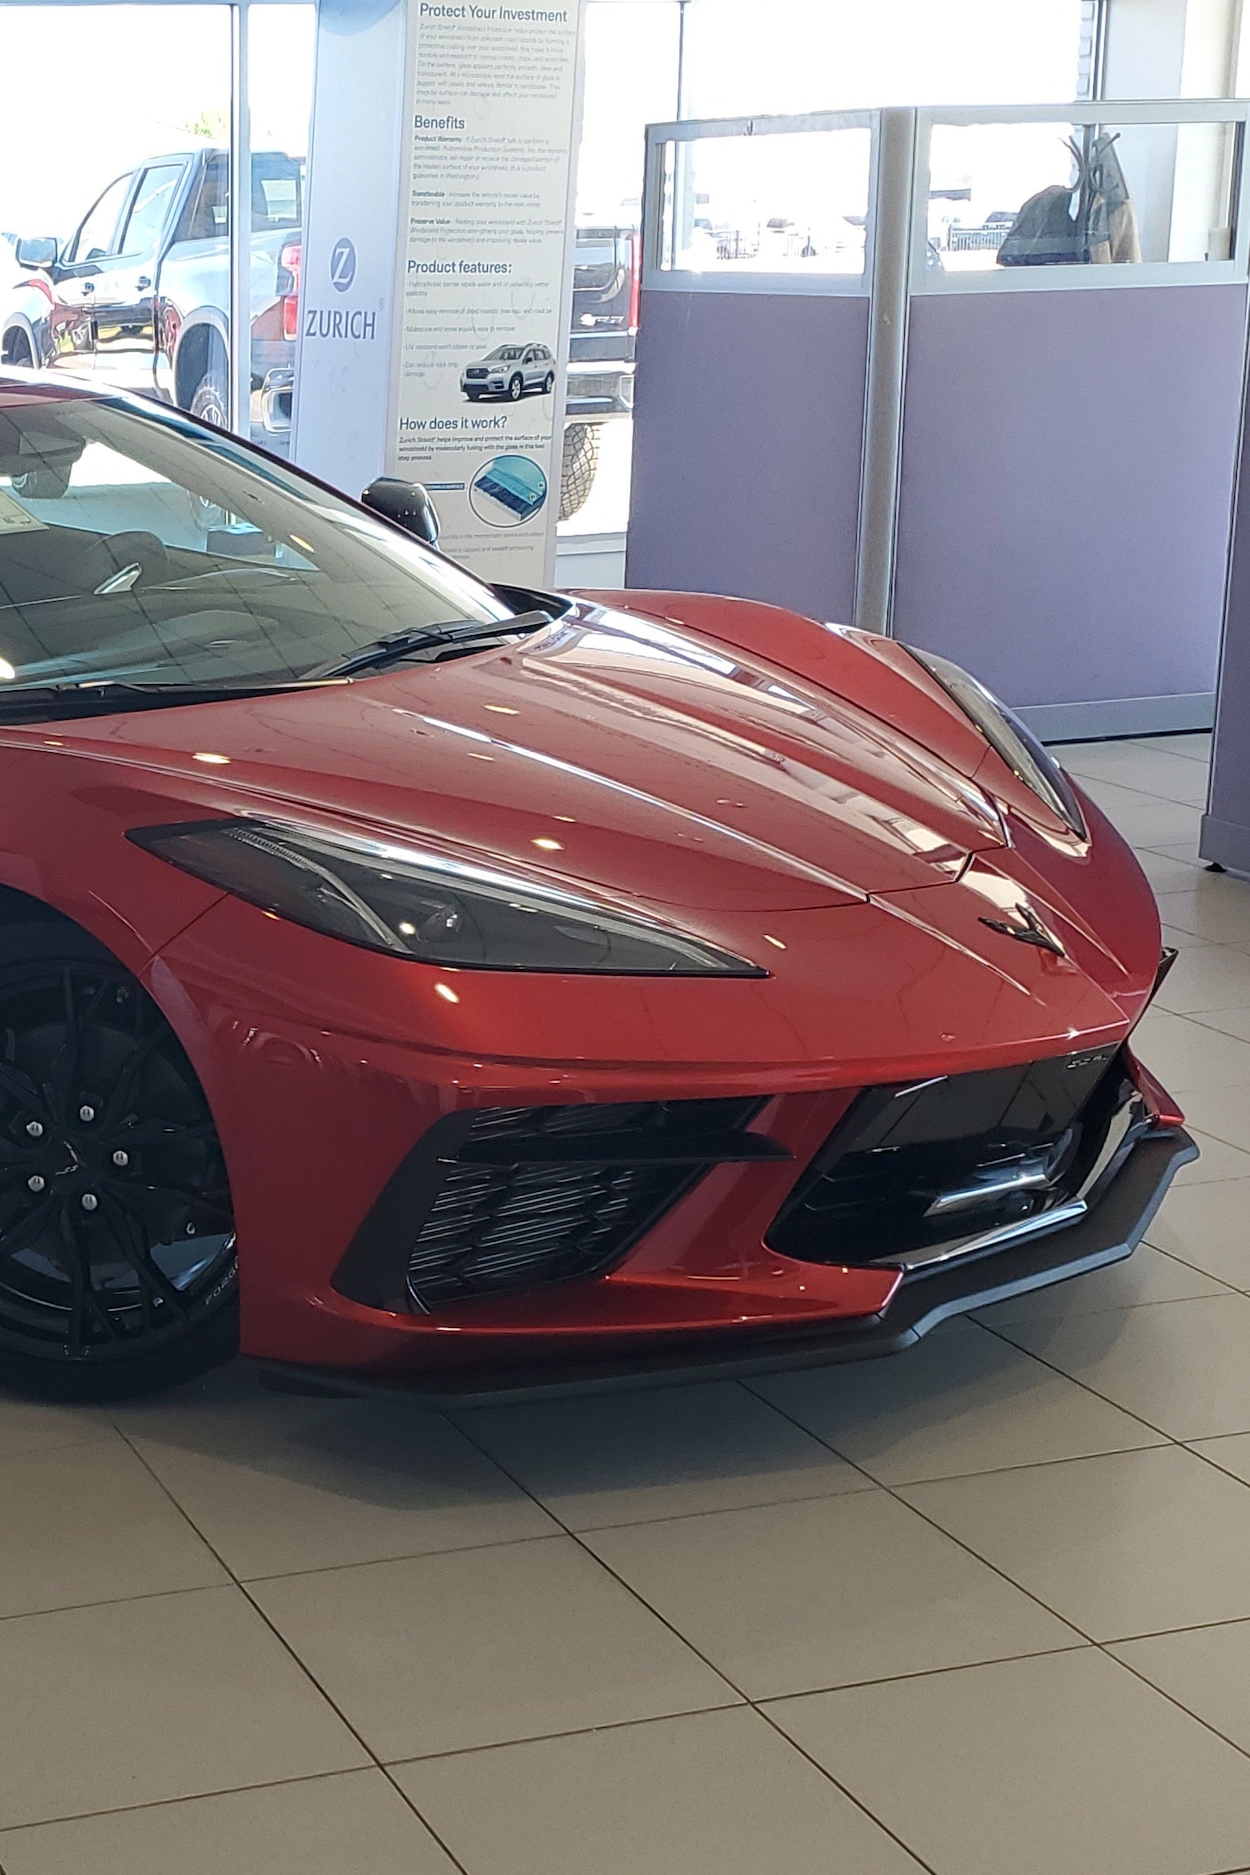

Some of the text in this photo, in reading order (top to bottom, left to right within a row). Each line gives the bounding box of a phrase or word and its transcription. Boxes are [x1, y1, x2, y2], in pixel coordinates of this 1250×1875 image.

[419, 3, 568, 23] Protect Your Investment
[414, 115, 465, 129] Benefits
[407, 260, 512, 274] Product features:
[305, 310, 376, 340] ZURICH
[399, 416, 507, 431] How does it work?
